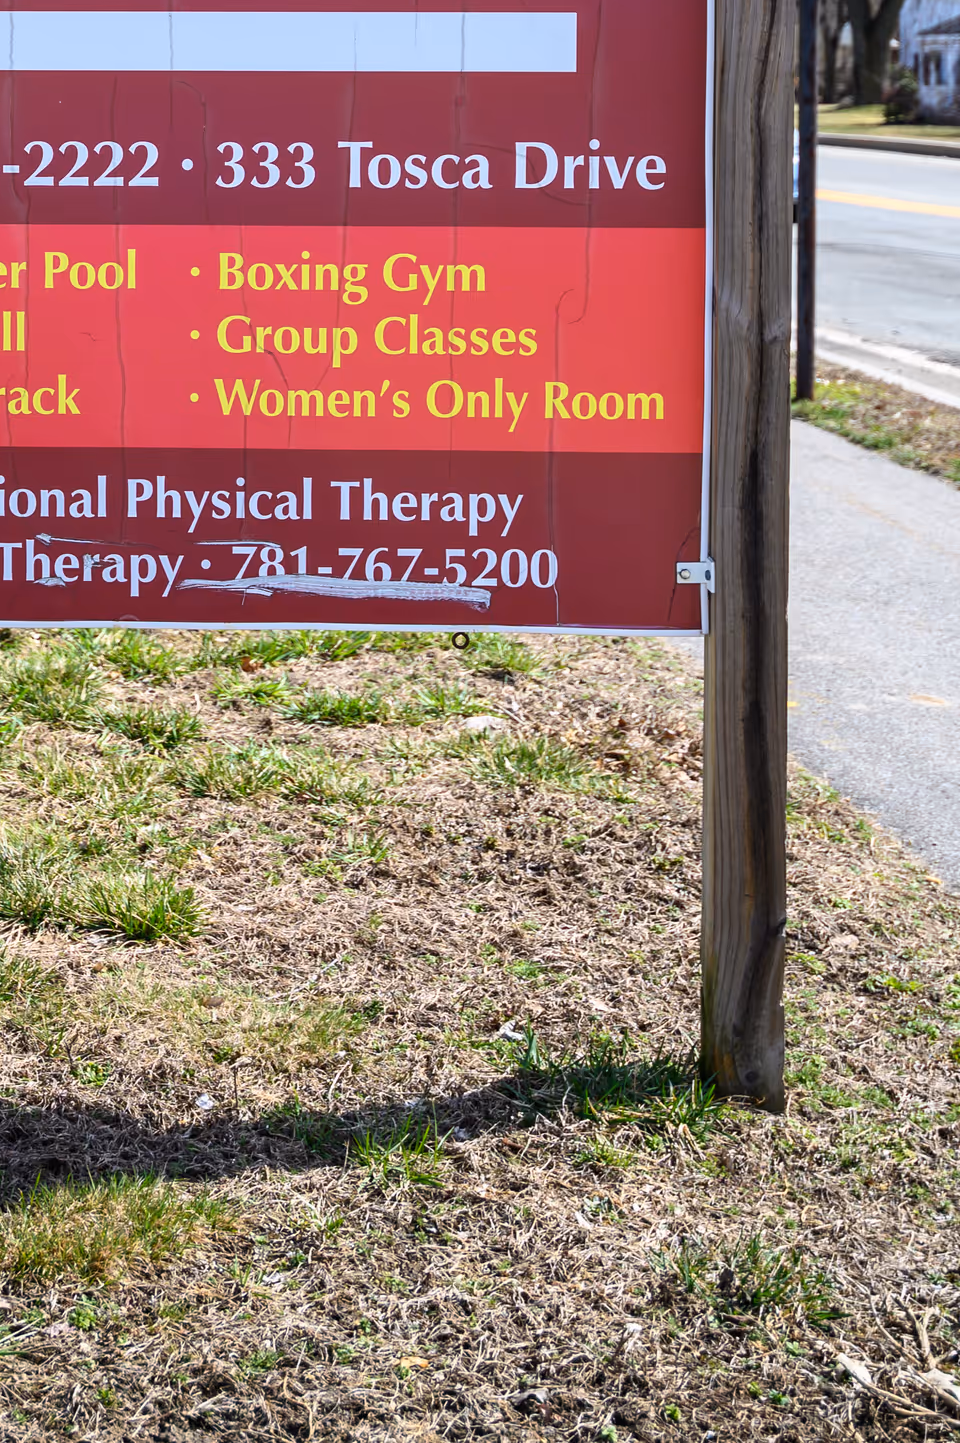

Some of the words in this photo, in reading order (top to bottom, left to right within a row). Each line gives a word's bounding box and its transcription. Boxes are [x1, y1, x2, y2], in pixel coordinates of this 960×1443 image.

[215, 141, 316, 189] 333
[338, 140, 494, 190] Tosca
[515, 138, 667, 191] Drive
[45, 248, 137, 290] Pool
[219, 251, 369, 306] Boxing
[382, 253, 486, 306] Gym
[216, 314, 357, 368] Group
[375, 313, 538, 357] Classes
[213, 378, 410, 418] Women's
[427, 377, 529, 433] Only
[545, 381, 664, 420] Room
[128, 475, 313, 534] Physical
[331, 477, 524, 537] Therapy
[231, 546, 559, 590] 781-767-5200
